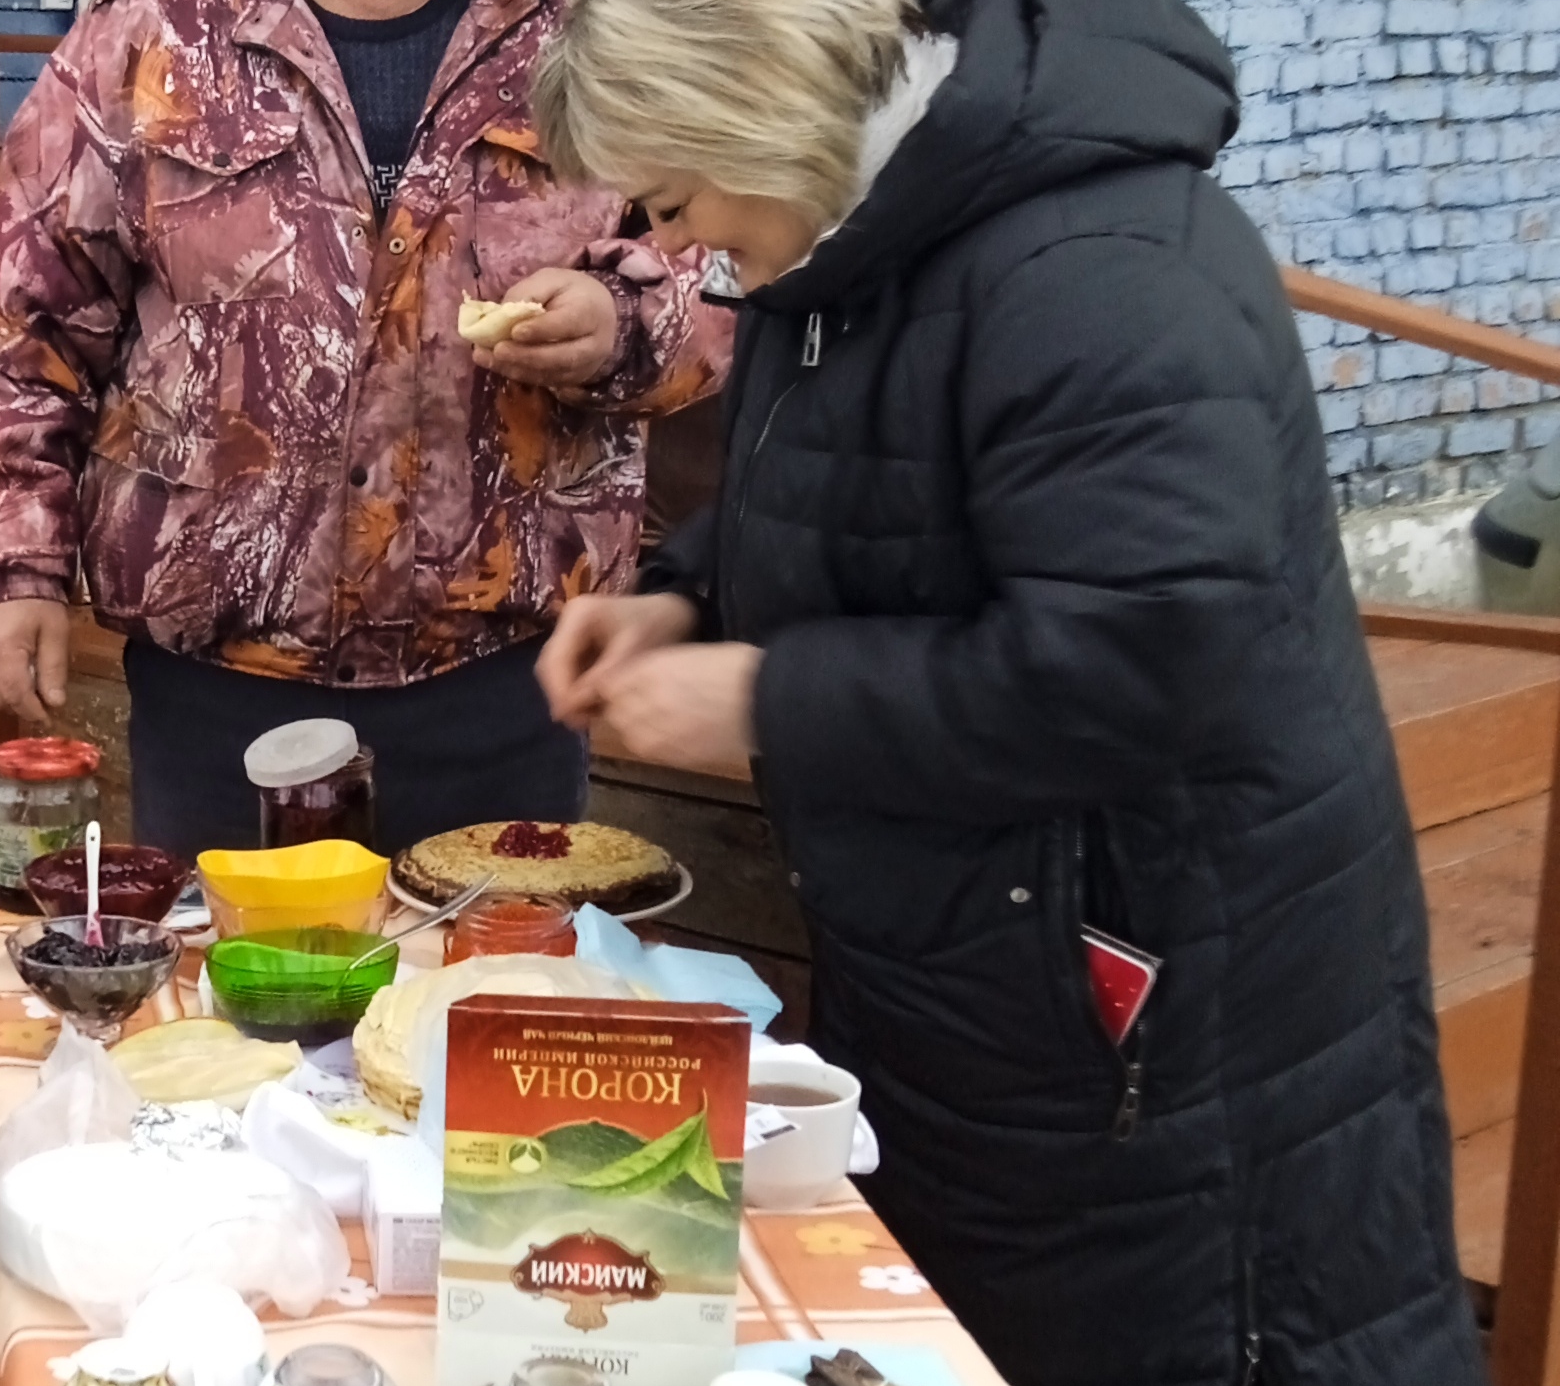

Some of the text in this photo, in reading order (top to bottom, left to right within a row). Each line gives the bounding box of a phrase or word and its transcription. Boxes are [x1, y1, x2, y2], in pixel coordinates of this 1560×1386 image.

[493, 1047, 701, 1070] РОССИЙСКОЙ ИМПЕРИИ
[511, 1065, 682, 1105] КОРОНА
[531, 1260, 647, 1290] МАЙСКИЙ
